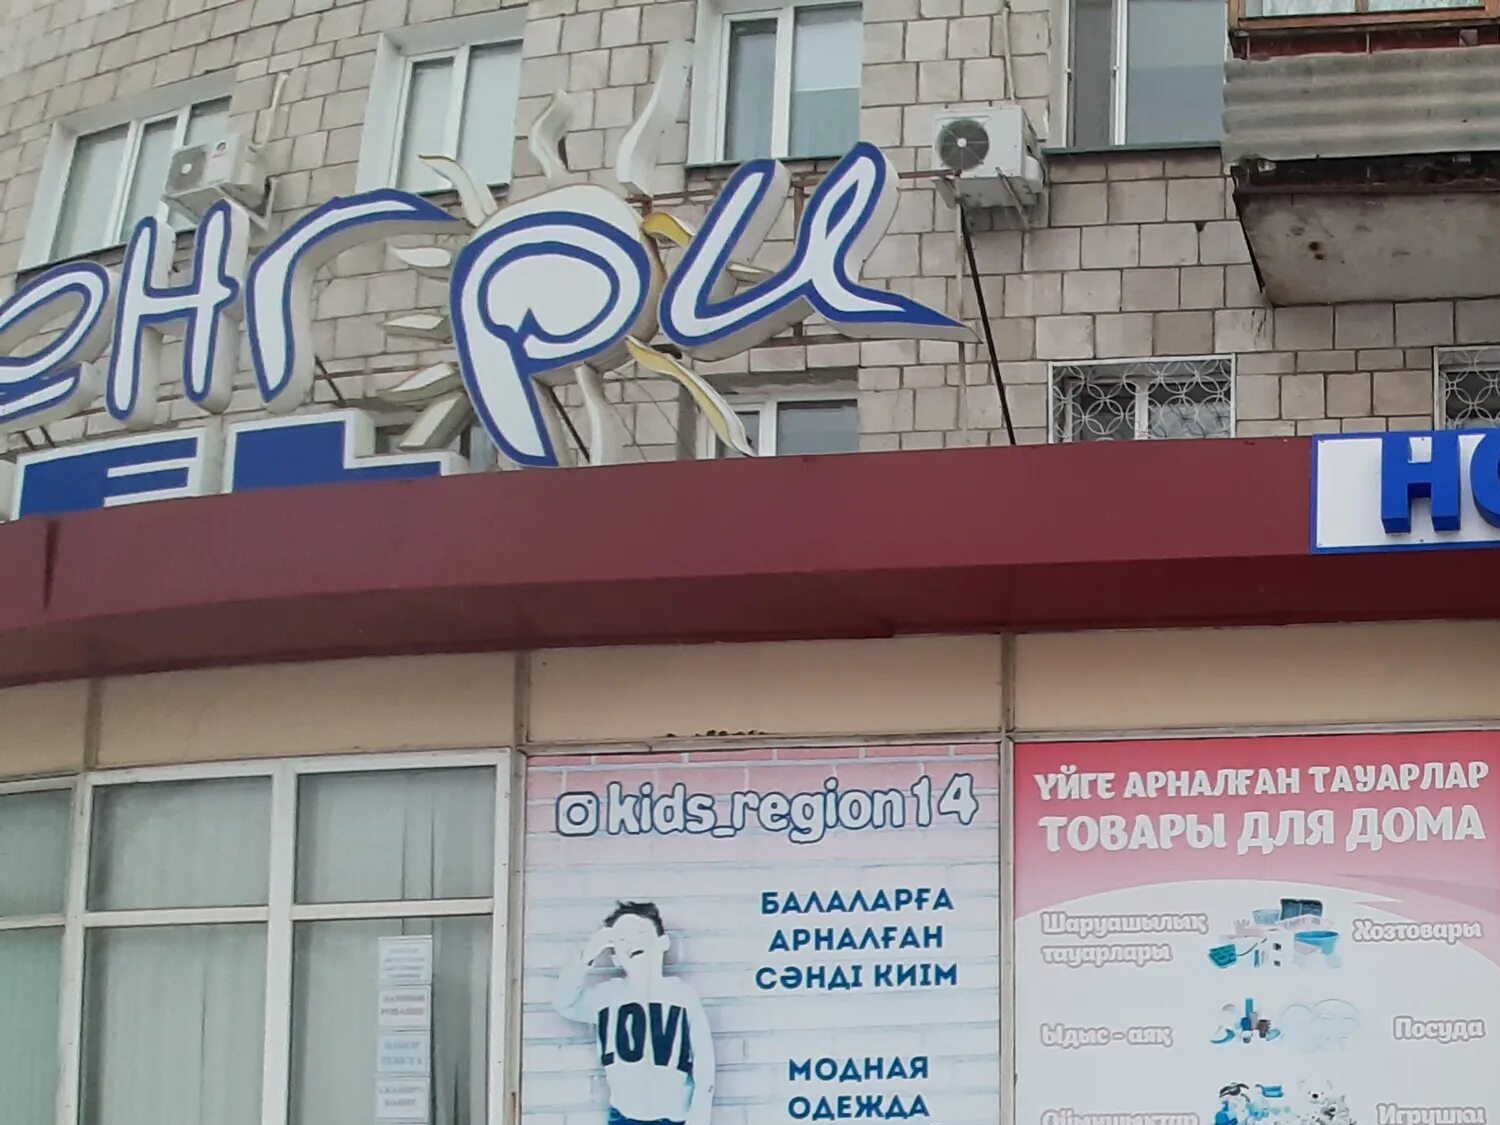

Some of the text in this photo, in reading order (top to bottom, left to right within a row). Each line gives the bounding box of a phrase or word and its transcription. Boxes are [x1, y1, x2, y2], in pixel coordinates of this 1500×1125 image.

[1033, 761, 1489, 800] ҮЙГЕ АРНАЛҒАН ТАУАРЛАР
[1038, 804, 1486, 855] ТОВАРЫ ДЛЯ ДОМА
[761, 887, 954, 914] БАЛАЛАРҒА
[768, 925, 943, 952] АРНАЛҒАН
[1352, 916, 1484, 945] Хозтовары
[1041, 944, 1173, 968] тауарлары
[755, 962, 958, 990] СӘНДІ КИІМ
[1393, 1015, 1486, 1041] Посуда
[788, 1056, 929, 1083] МОДНАЯ
[788, 1094, 930, 1121] ОДЕЖДА
